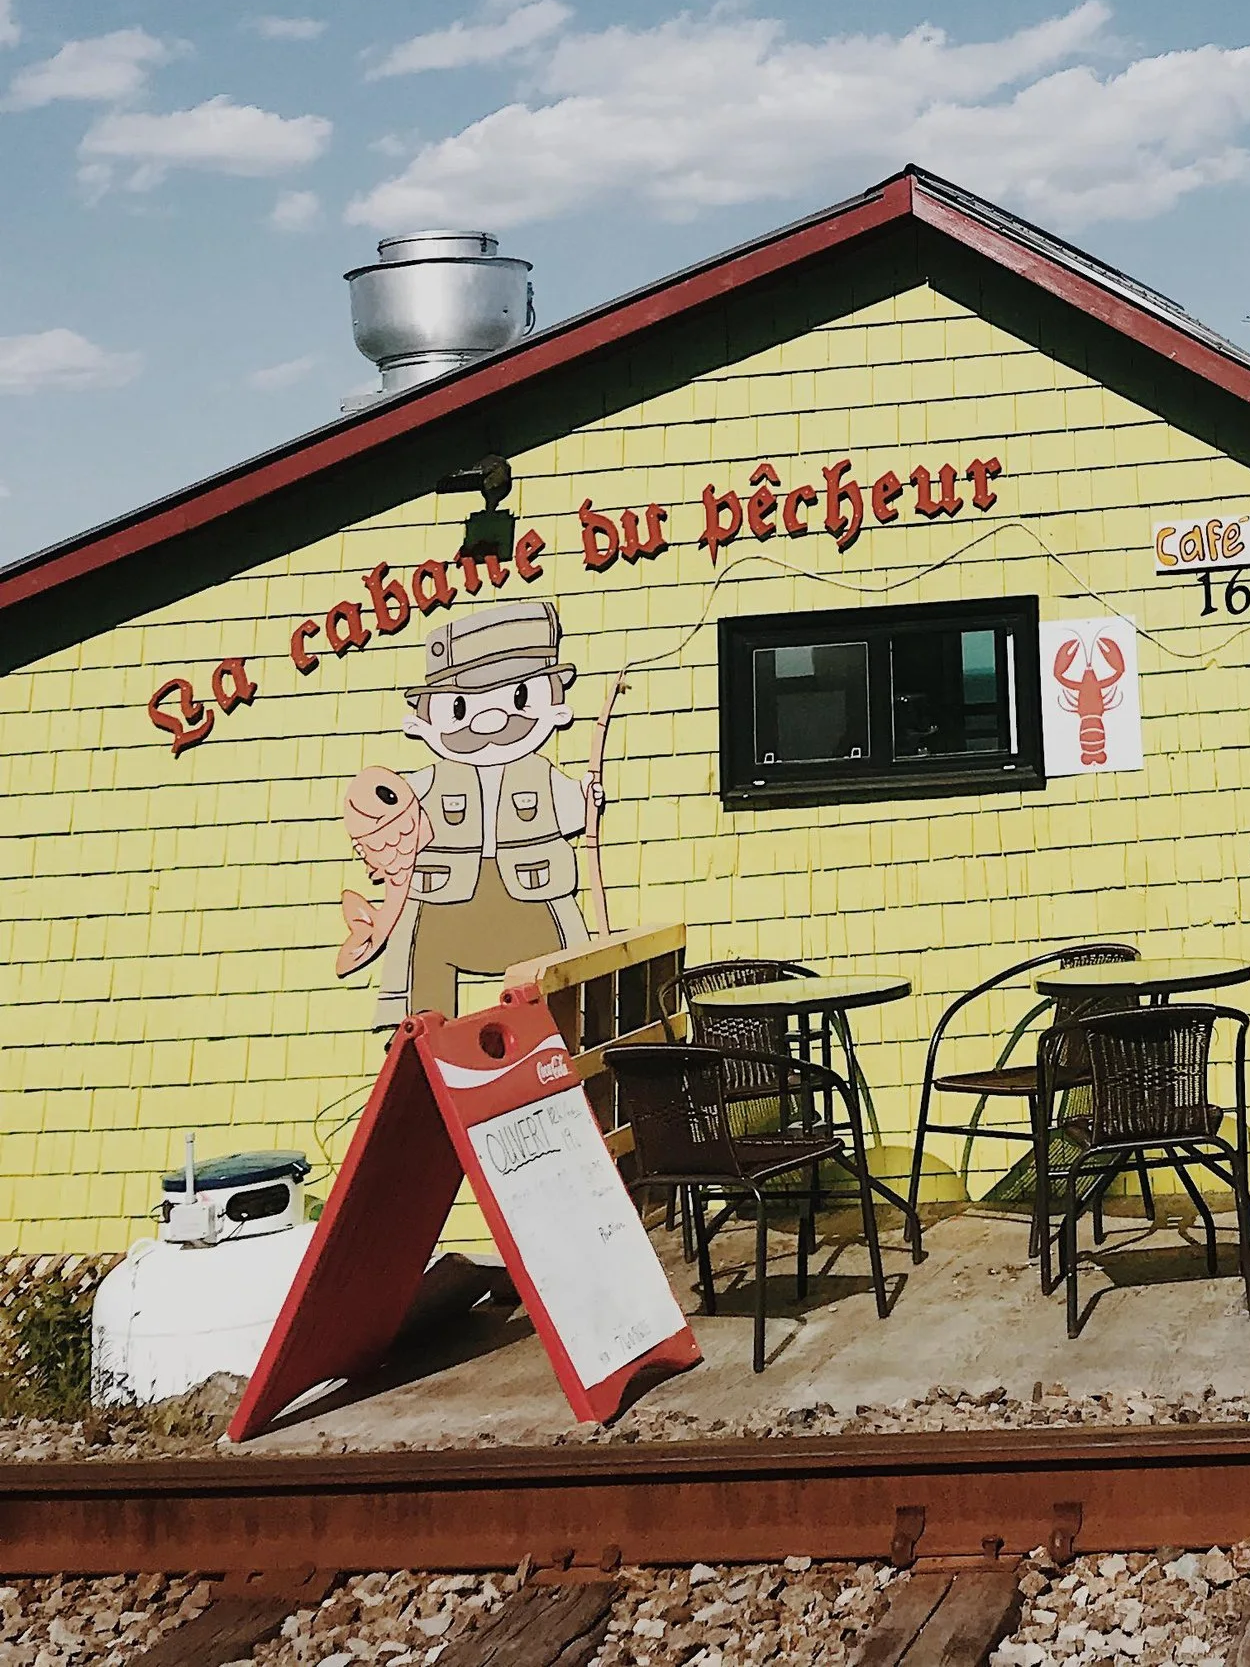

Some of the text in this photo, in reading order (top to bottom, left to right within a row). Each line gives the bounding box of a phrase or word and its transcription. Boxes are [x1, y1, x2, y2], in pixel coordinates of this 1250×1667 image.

[1156, 515, 1250, 566] Café
[147, 456, 1003, 756] La cabane du pêcheur
[486, 1109, 551, 1173] OUVERT
